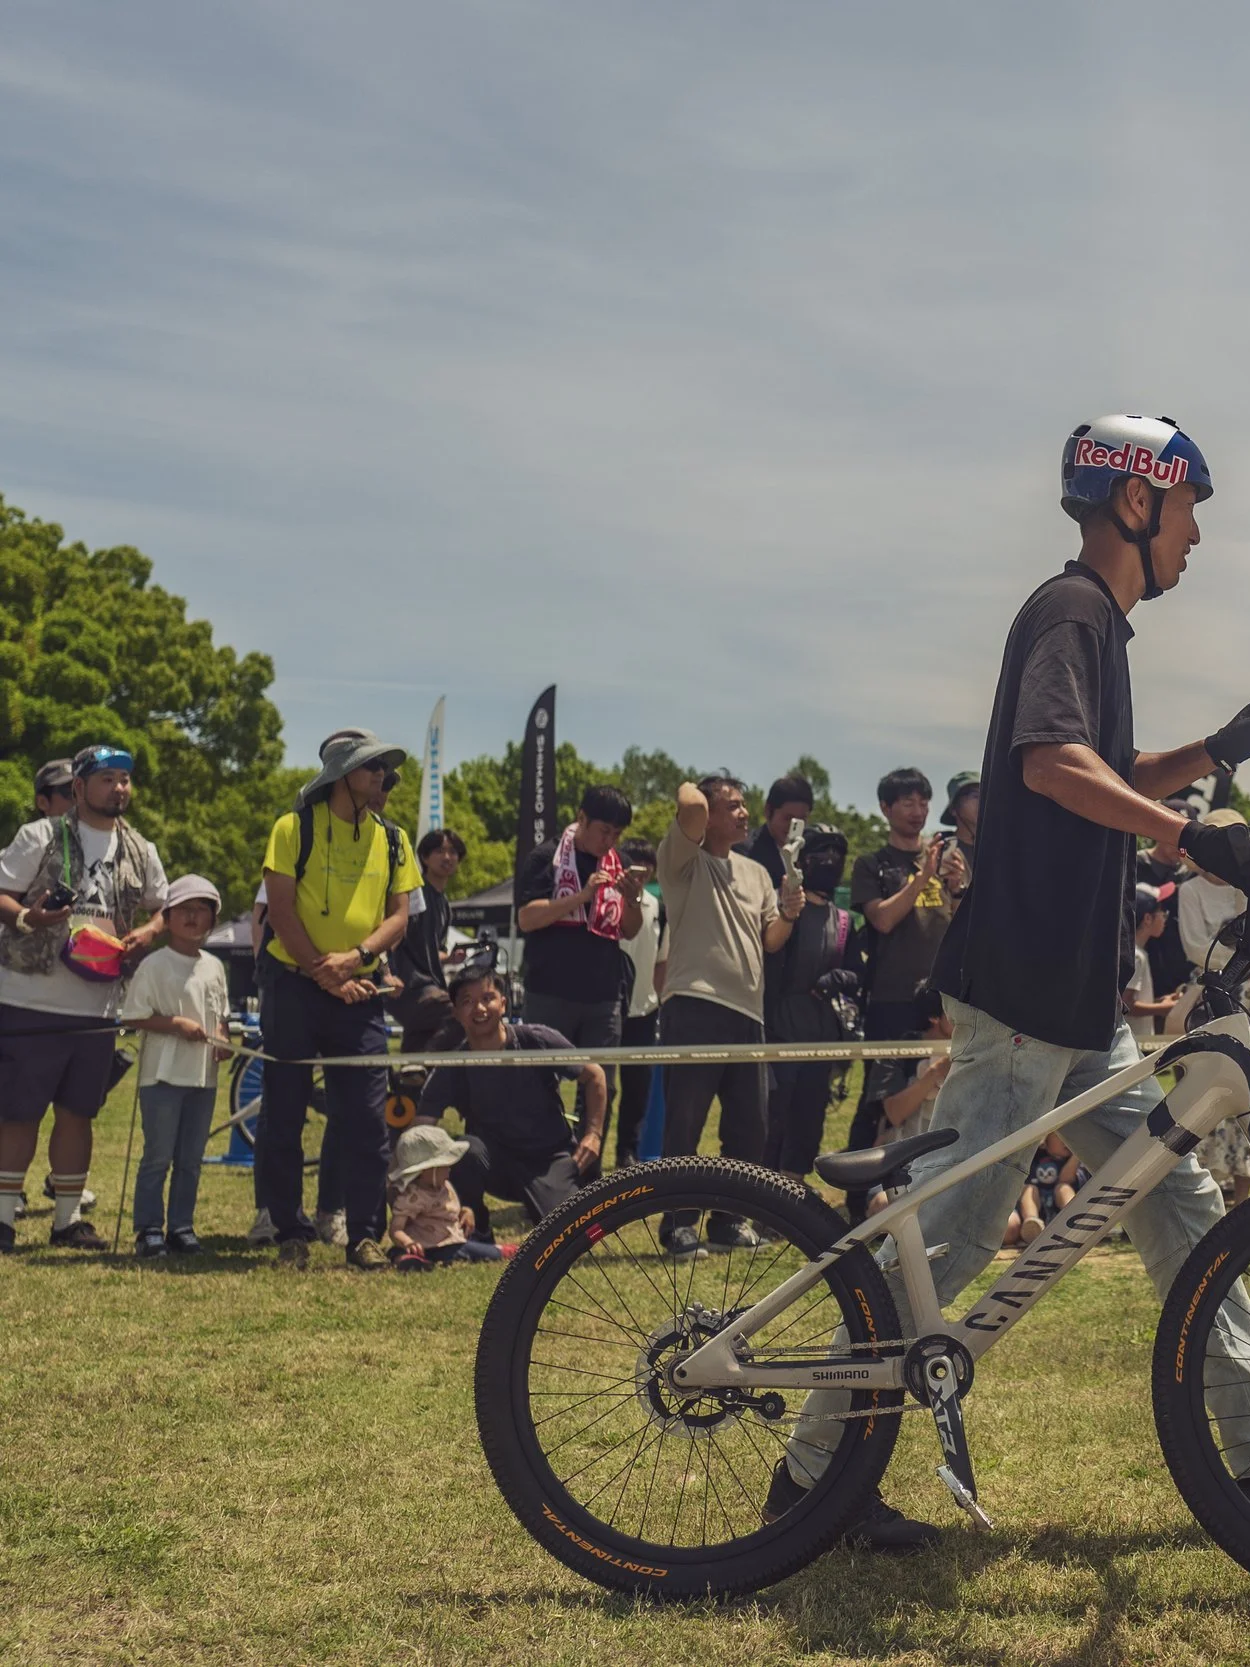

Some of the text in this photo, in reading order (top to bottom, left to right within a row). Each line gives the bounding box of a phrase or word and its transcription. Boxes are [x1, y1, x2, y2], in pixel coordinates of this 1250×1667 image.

[1075, 438, 1188, 485] Red Bull
[534, 1185, 654, 1271] CONTINENTAL
[965, 1186, 1138, 1332] CANYON
[1175, 1250, 1230, 1384] CONTINENTAL
[812, 1370, 870, 1381] SHIMANO
[542, 1502, 668, 1577] CONTINENTAL
